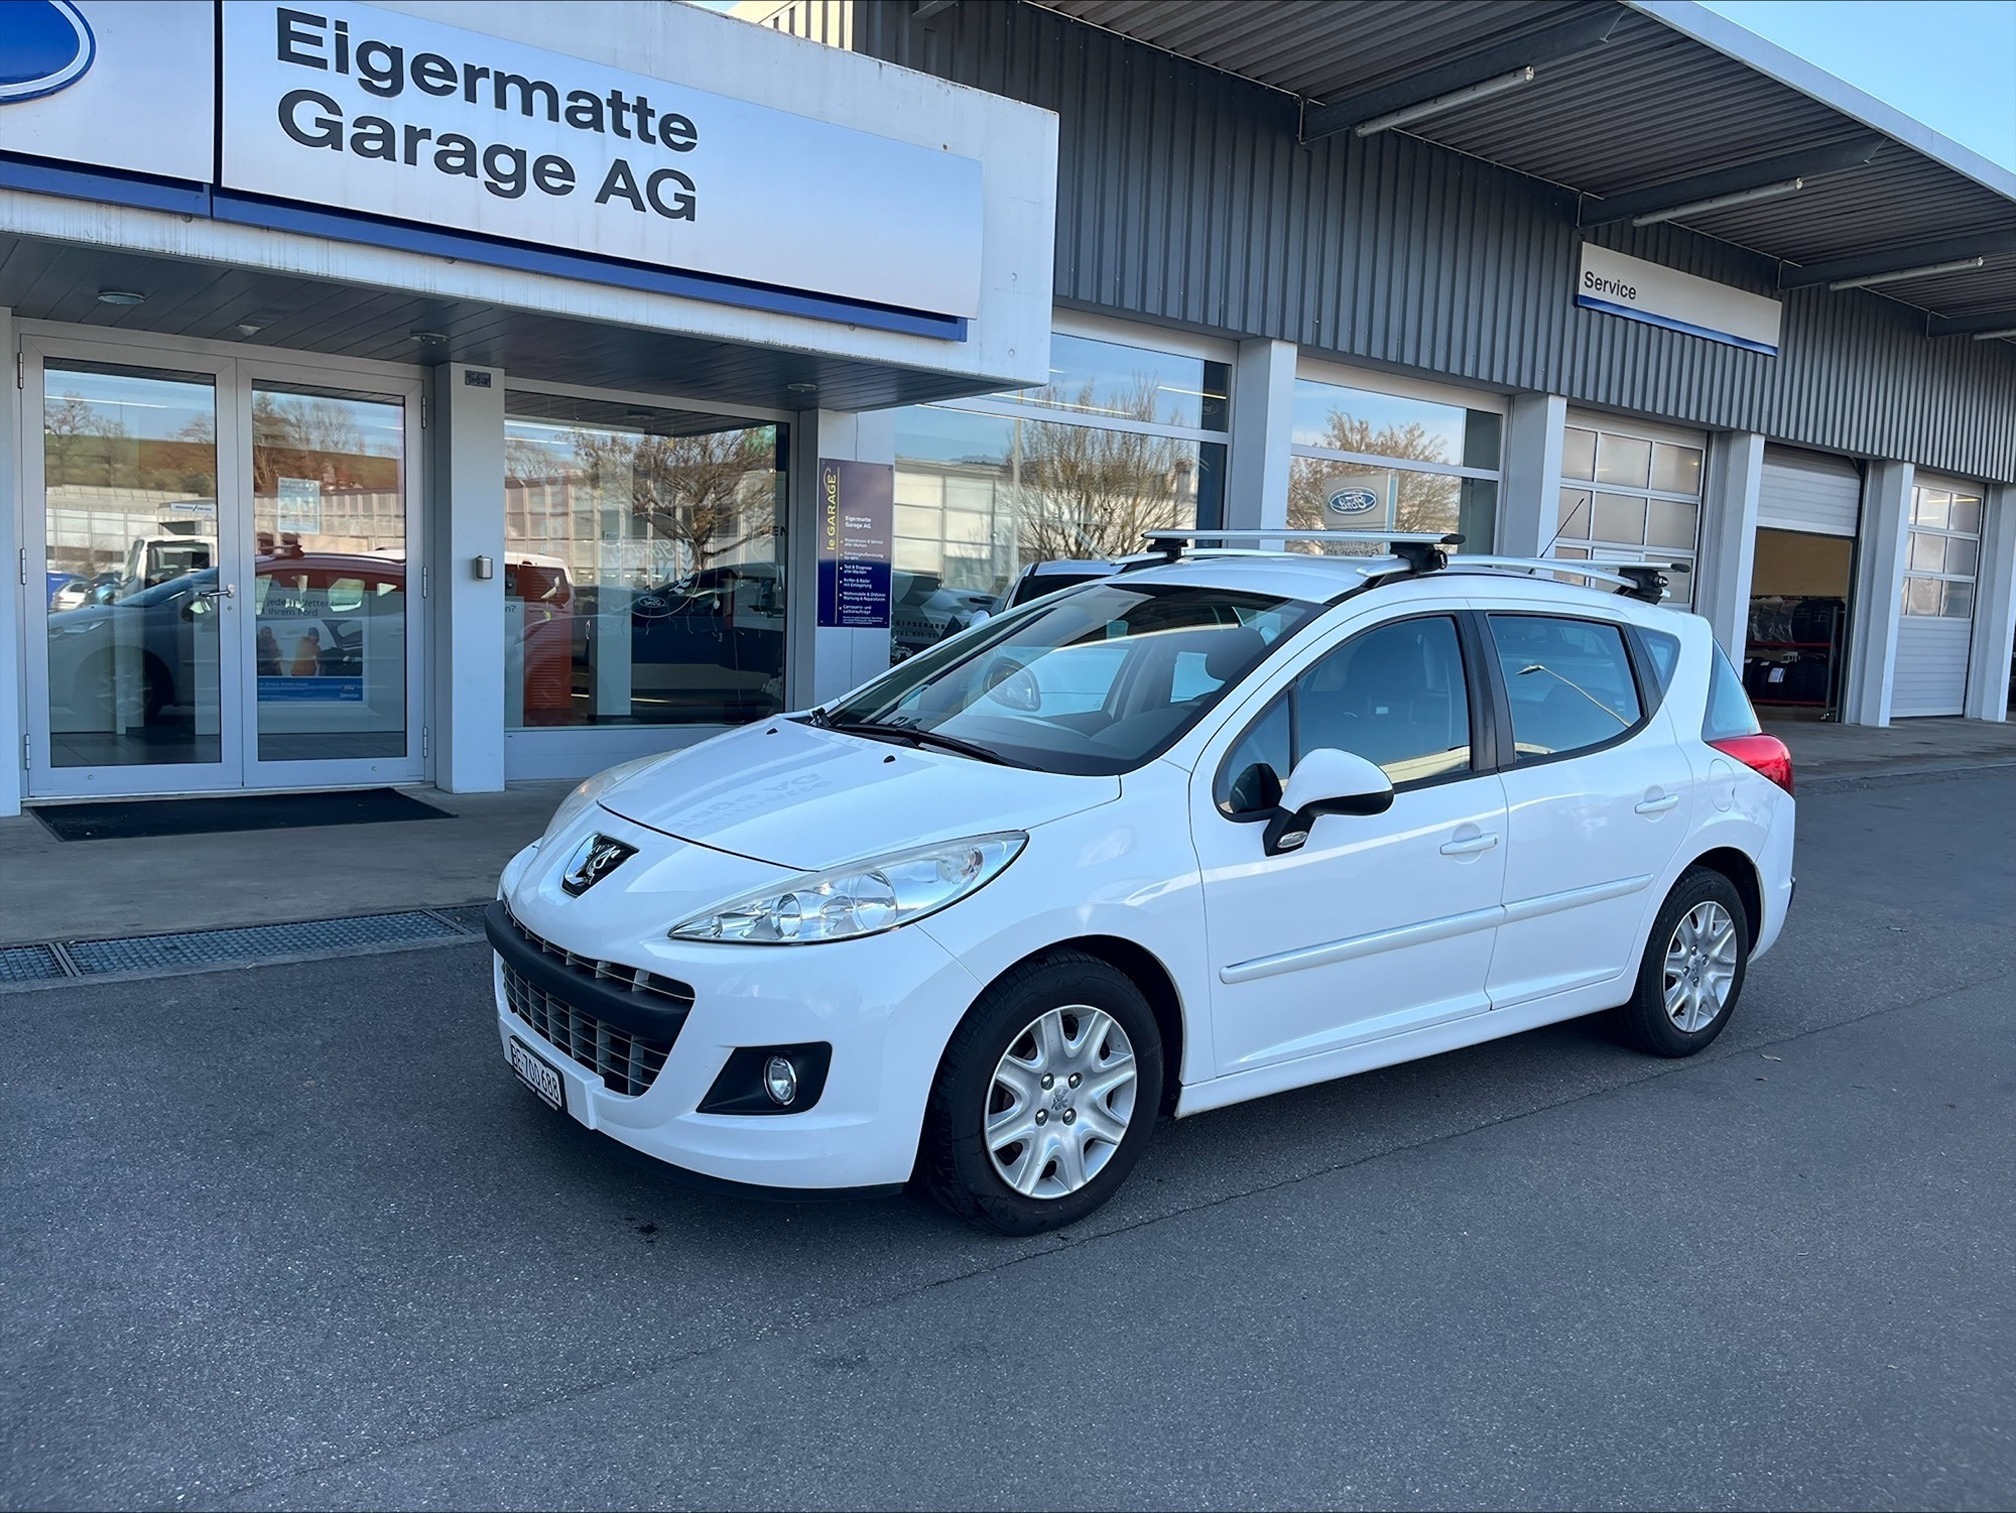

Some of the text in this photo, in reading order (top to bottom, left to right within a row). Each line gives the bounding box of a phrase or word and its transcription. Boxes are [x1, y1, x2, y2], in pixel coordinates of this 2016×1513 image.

[277, 7, 698, 153] Eigermatte
[278, 89, 697, 221] Garage AG
[1584, 271, 1636, 300] Service
[827, 474, 836, 550] le GARAGE
